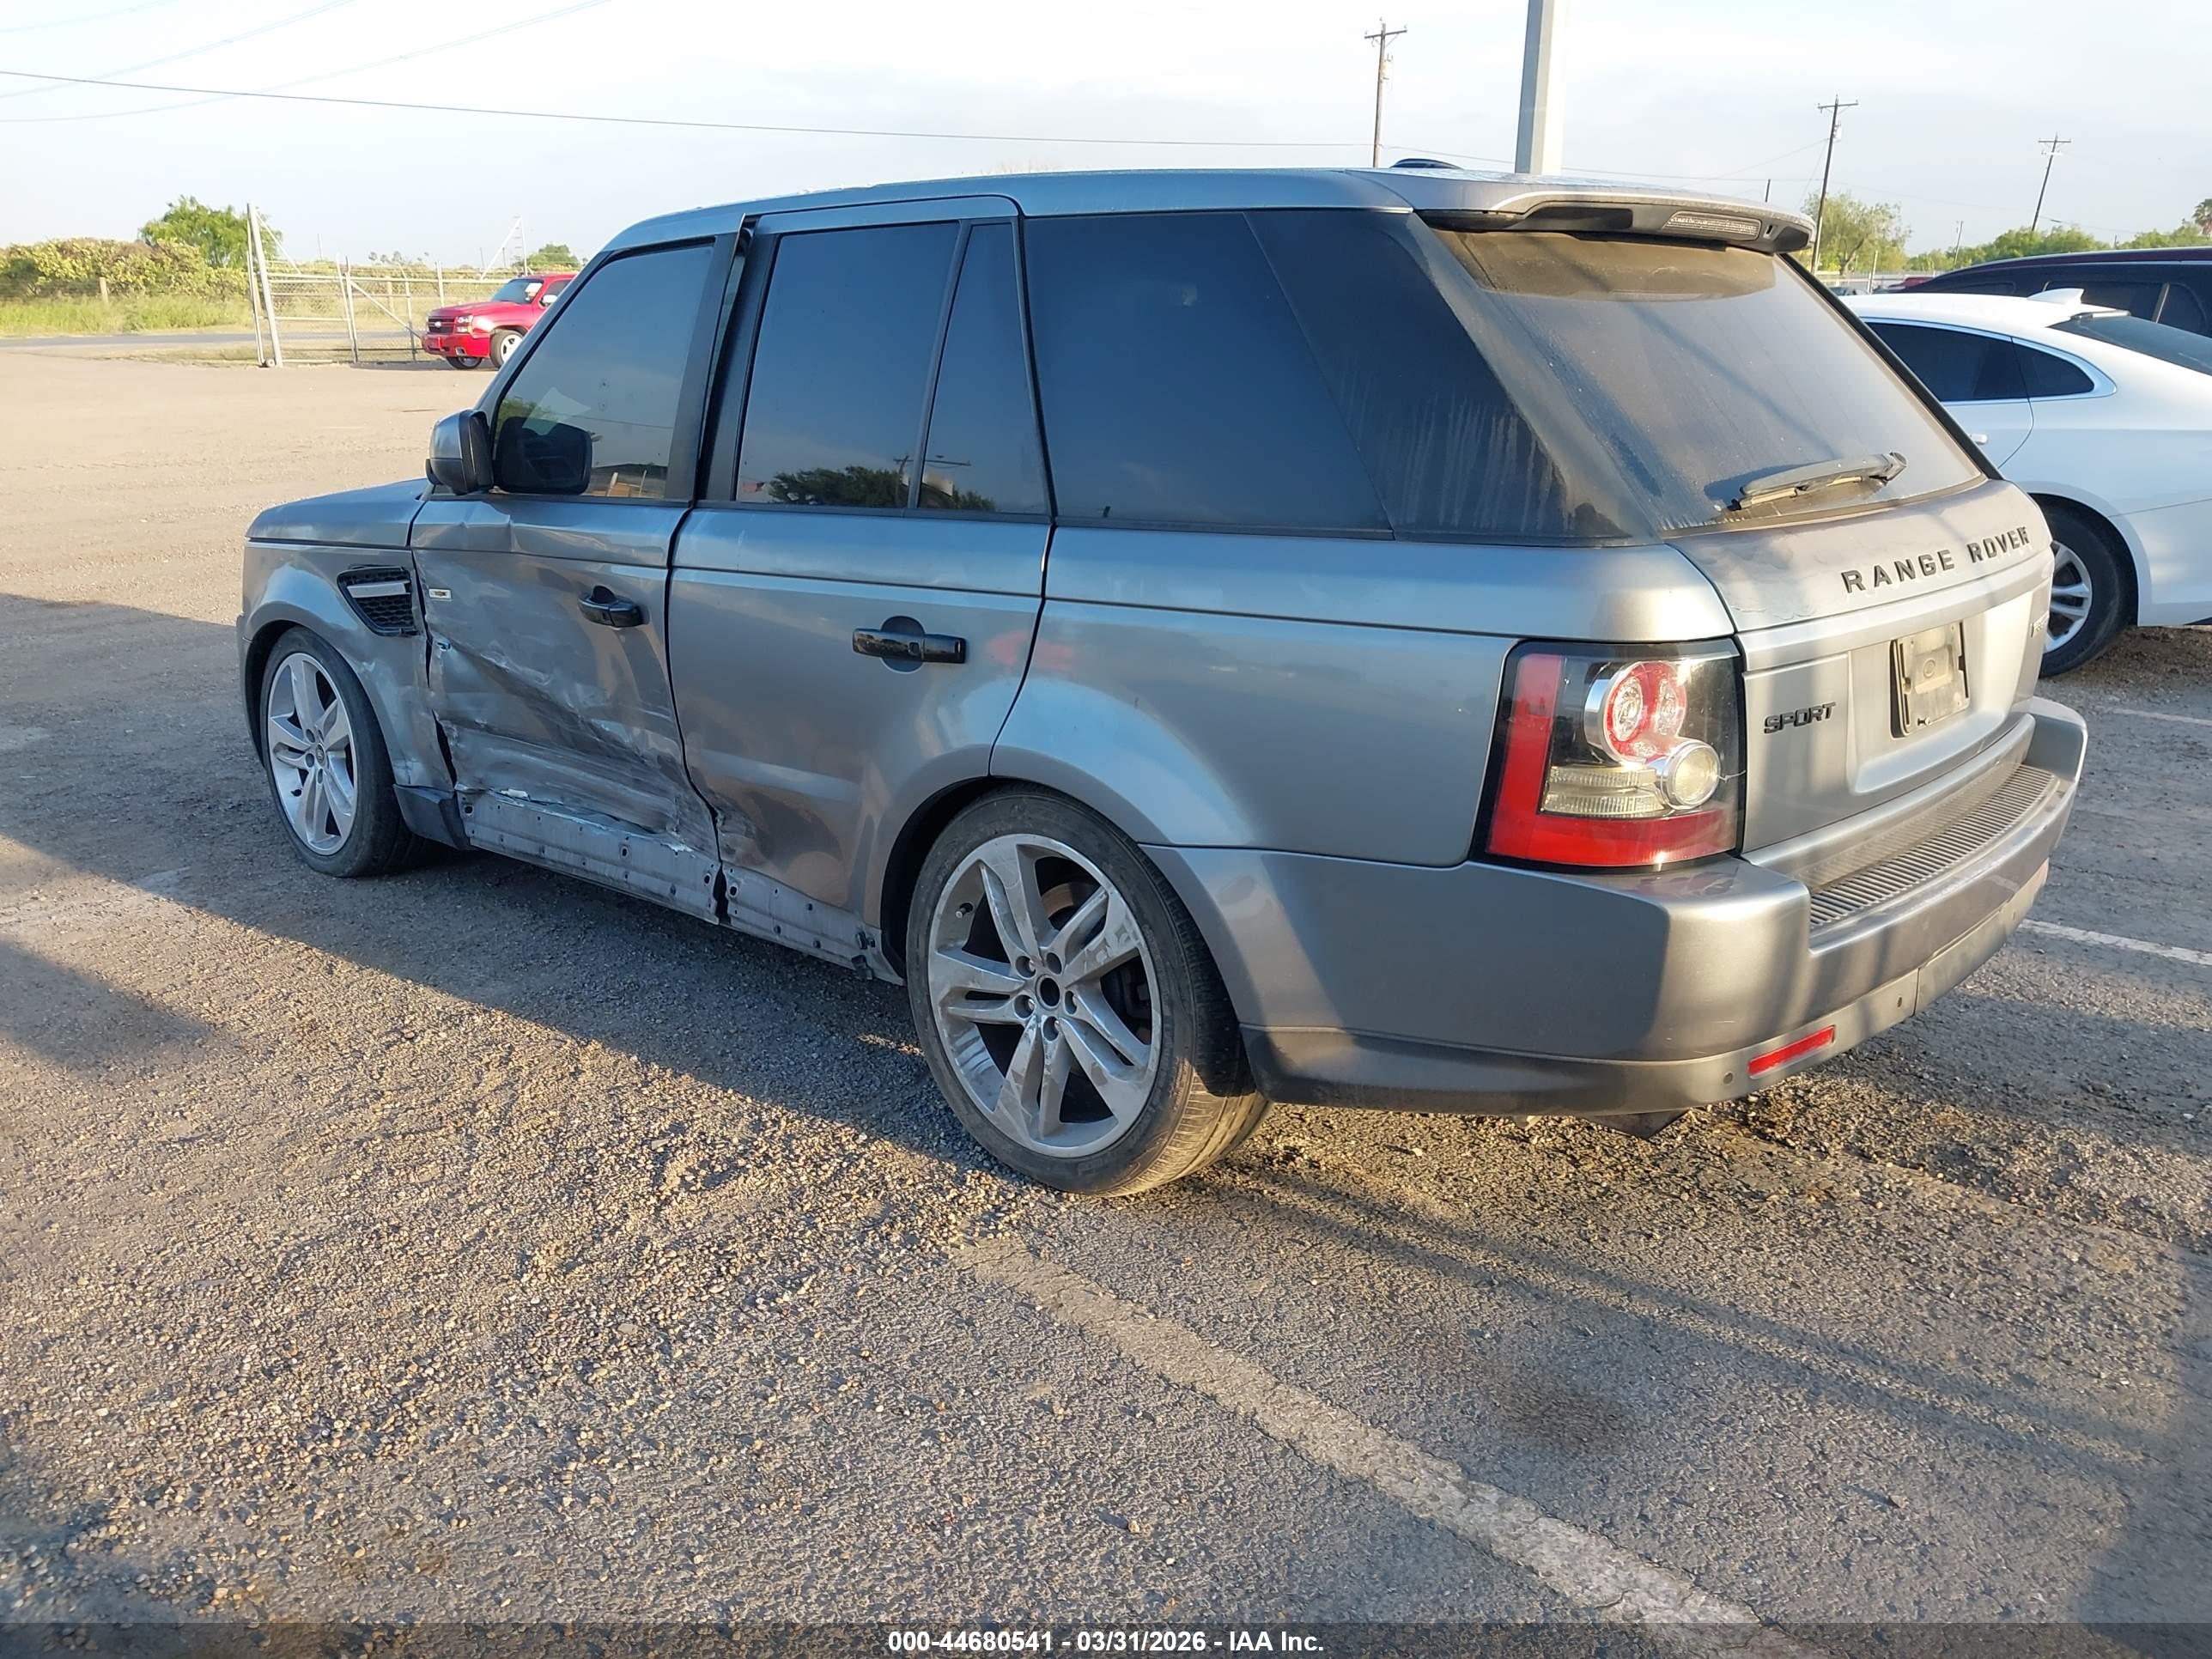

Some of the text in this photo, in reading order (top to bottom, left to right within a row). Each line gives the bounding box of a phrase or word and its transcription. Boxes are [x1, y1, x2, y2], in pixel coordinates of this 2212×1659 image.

[1840, 526, 2031, 594] RANGE ROVER
[1764, 701, 1836, 734] SPORT
